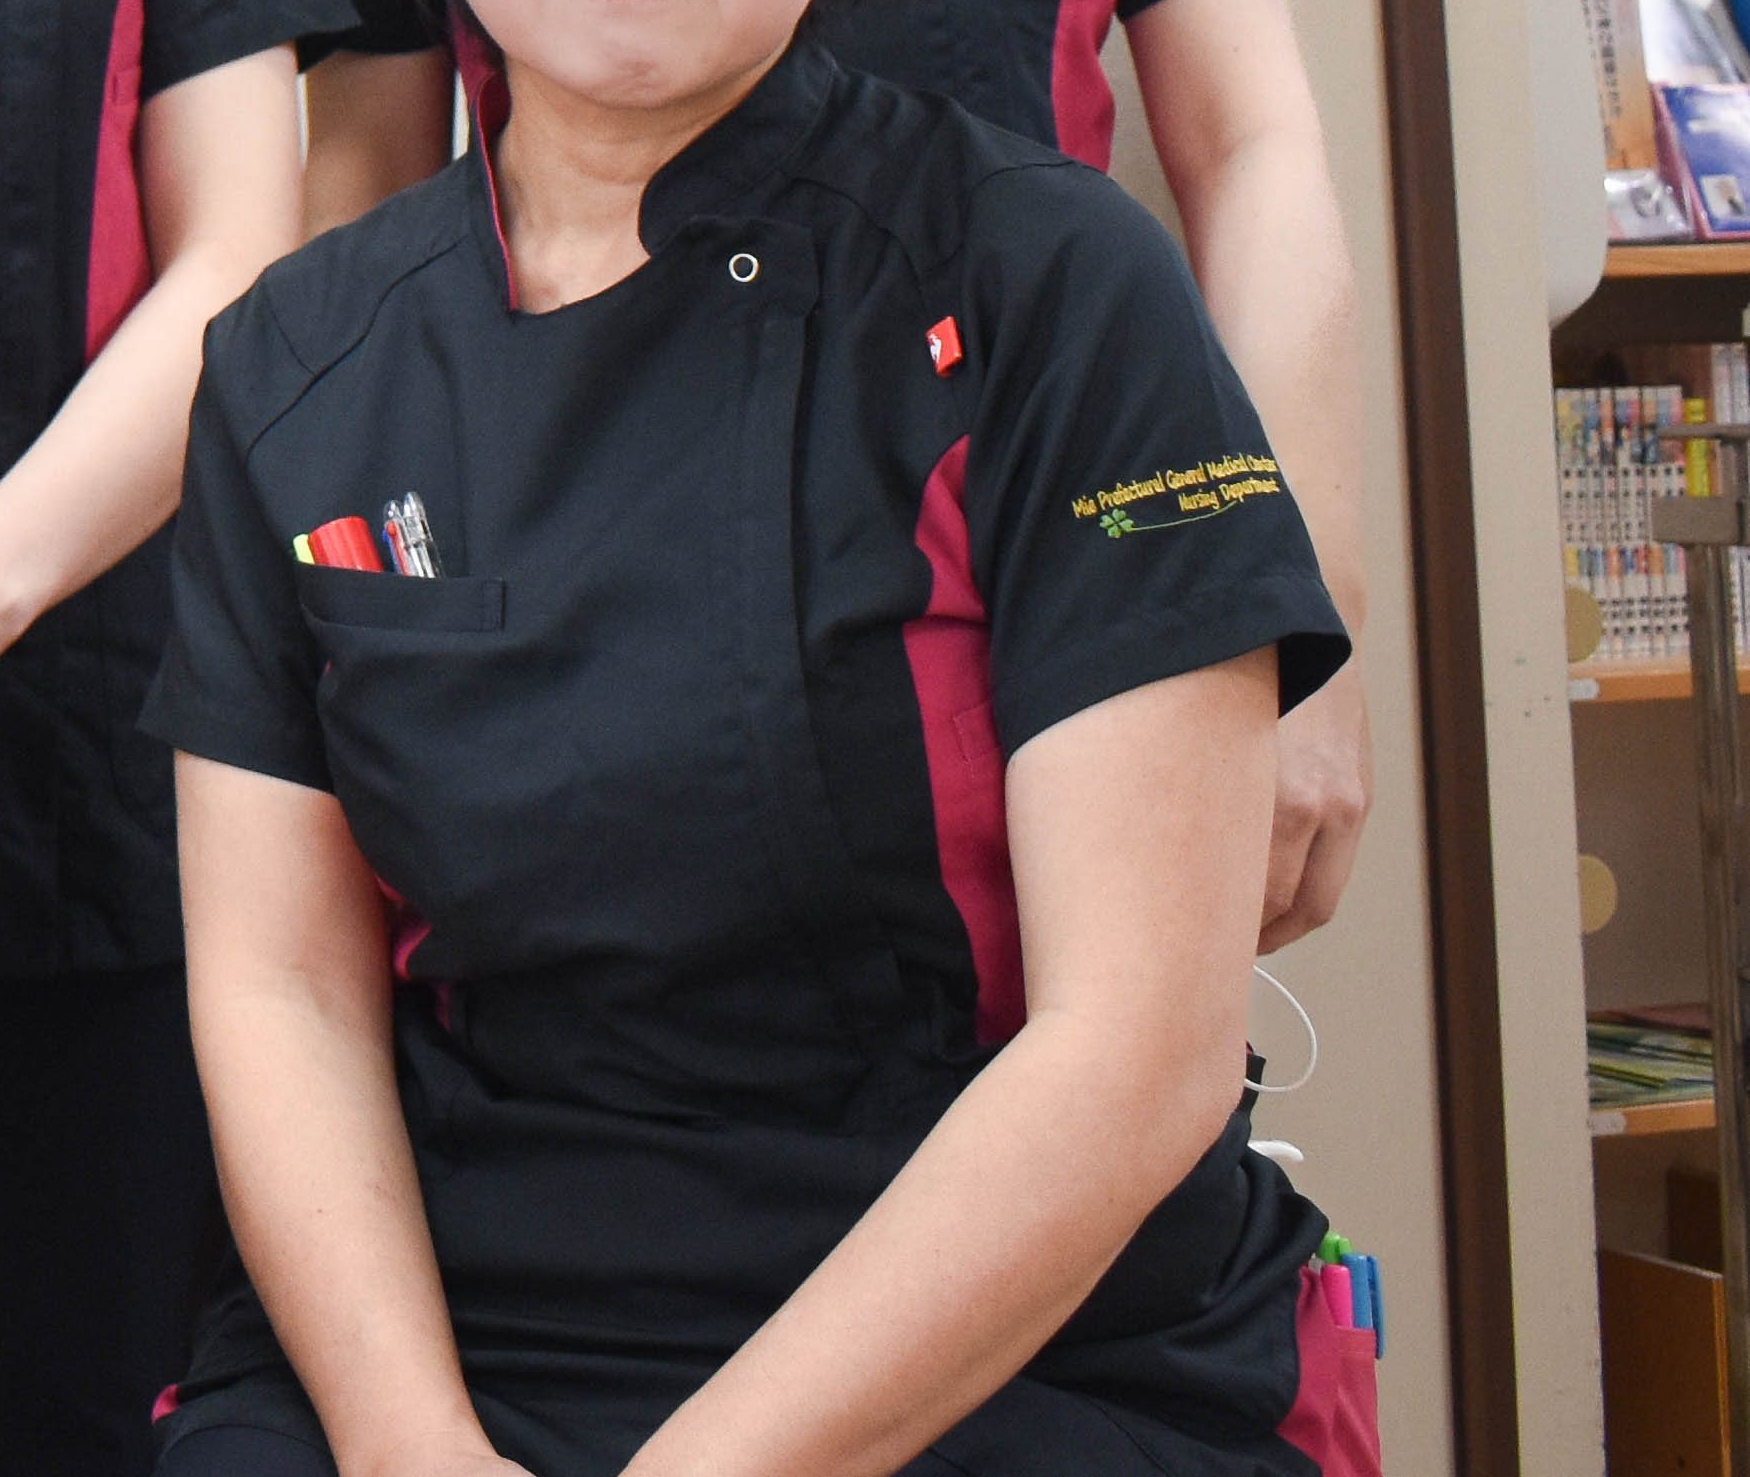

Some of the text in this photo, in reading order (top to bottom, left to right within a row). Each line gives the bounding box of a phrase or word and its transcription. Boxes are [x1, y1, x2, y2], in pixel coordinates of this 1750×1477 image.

[1071, 495, 1098, 518] Mie
[1097, 471, 1166, 510] Prefectural
[1166, 462, 1207, 490] General
[1207, 453, 1250, 479] Medical
[1178, 488, 1220, 512] Nursing
